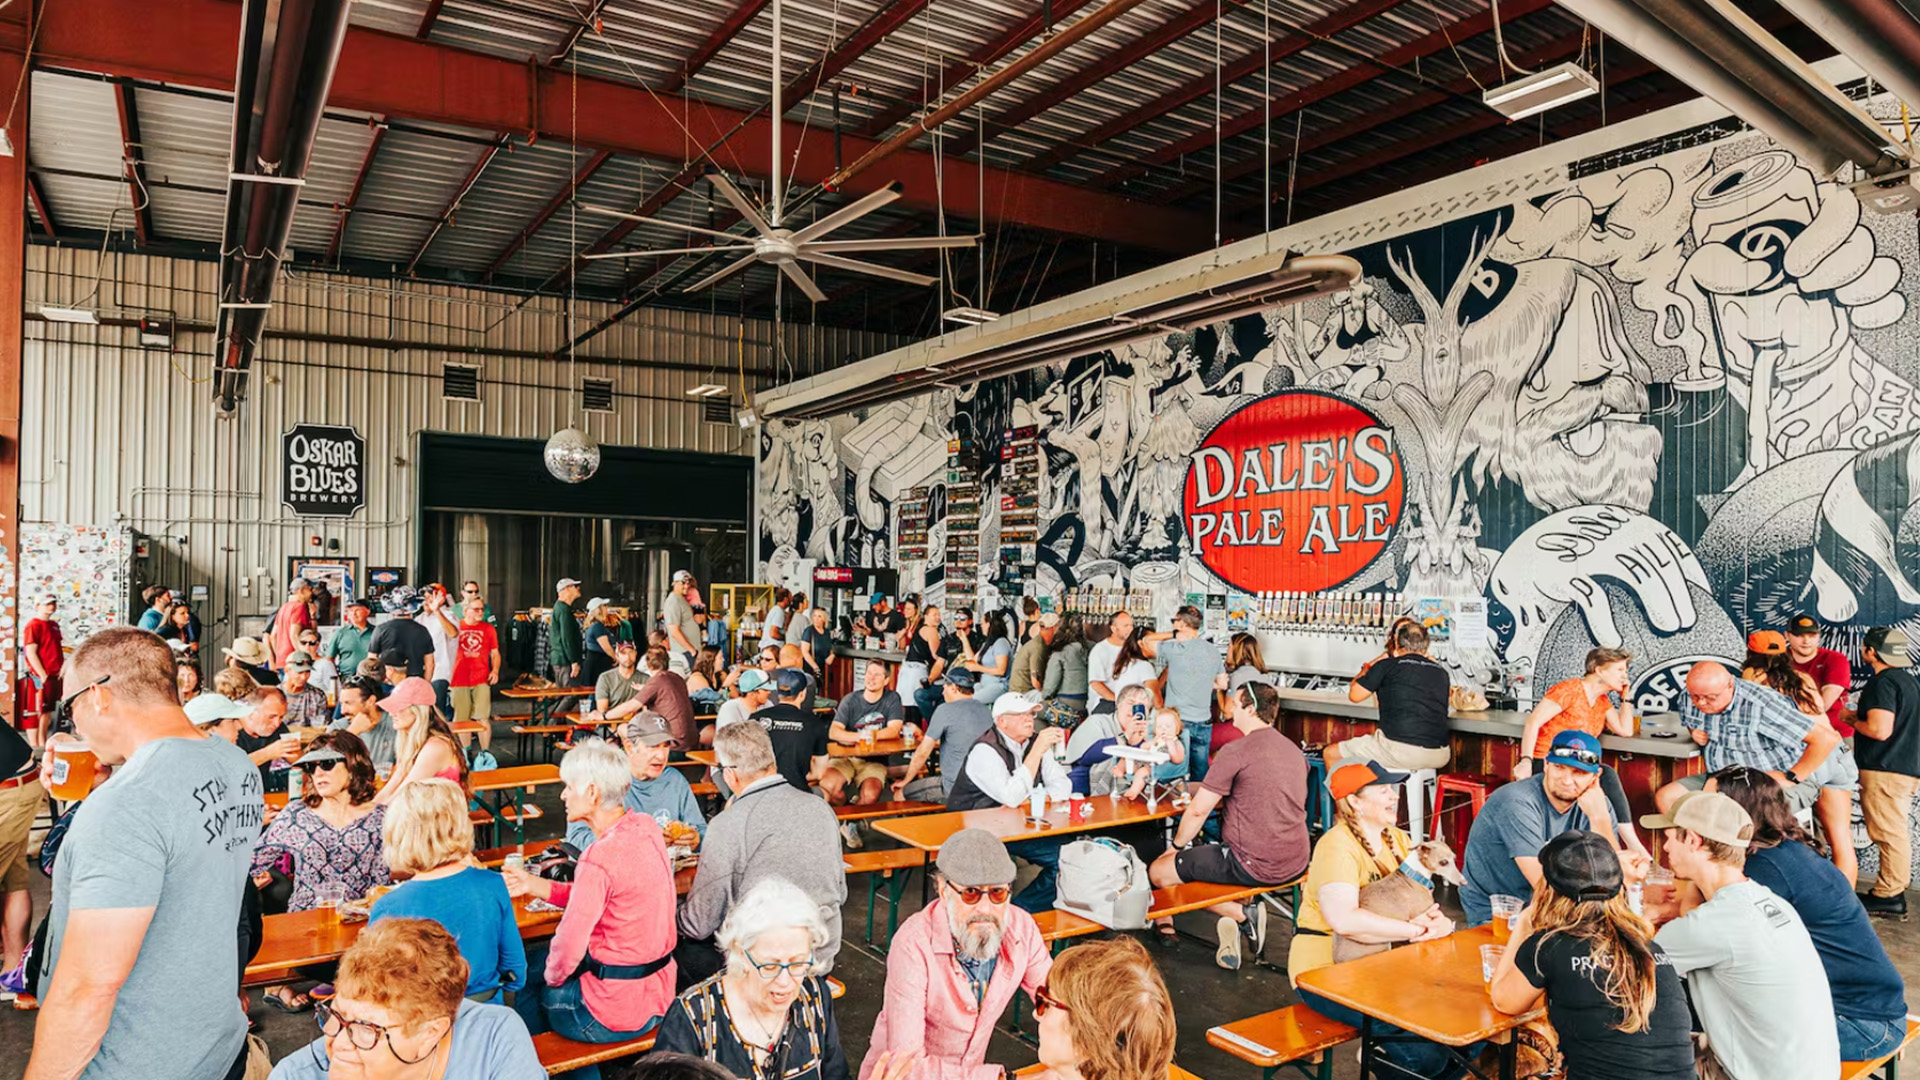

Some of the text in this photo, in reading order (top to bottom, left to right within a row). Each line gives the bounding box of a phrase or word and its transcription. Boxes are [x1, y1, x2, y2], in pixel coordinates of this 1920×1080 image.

[289, 434, 359, 468] OSKAR
[1190, 425, 1394, 508] DALE'S
[289, 464, 358, 494] BLUES
[289, 493, 357, 504] BREWERY
[1190, 501, 1392, 556] PALE ALE
